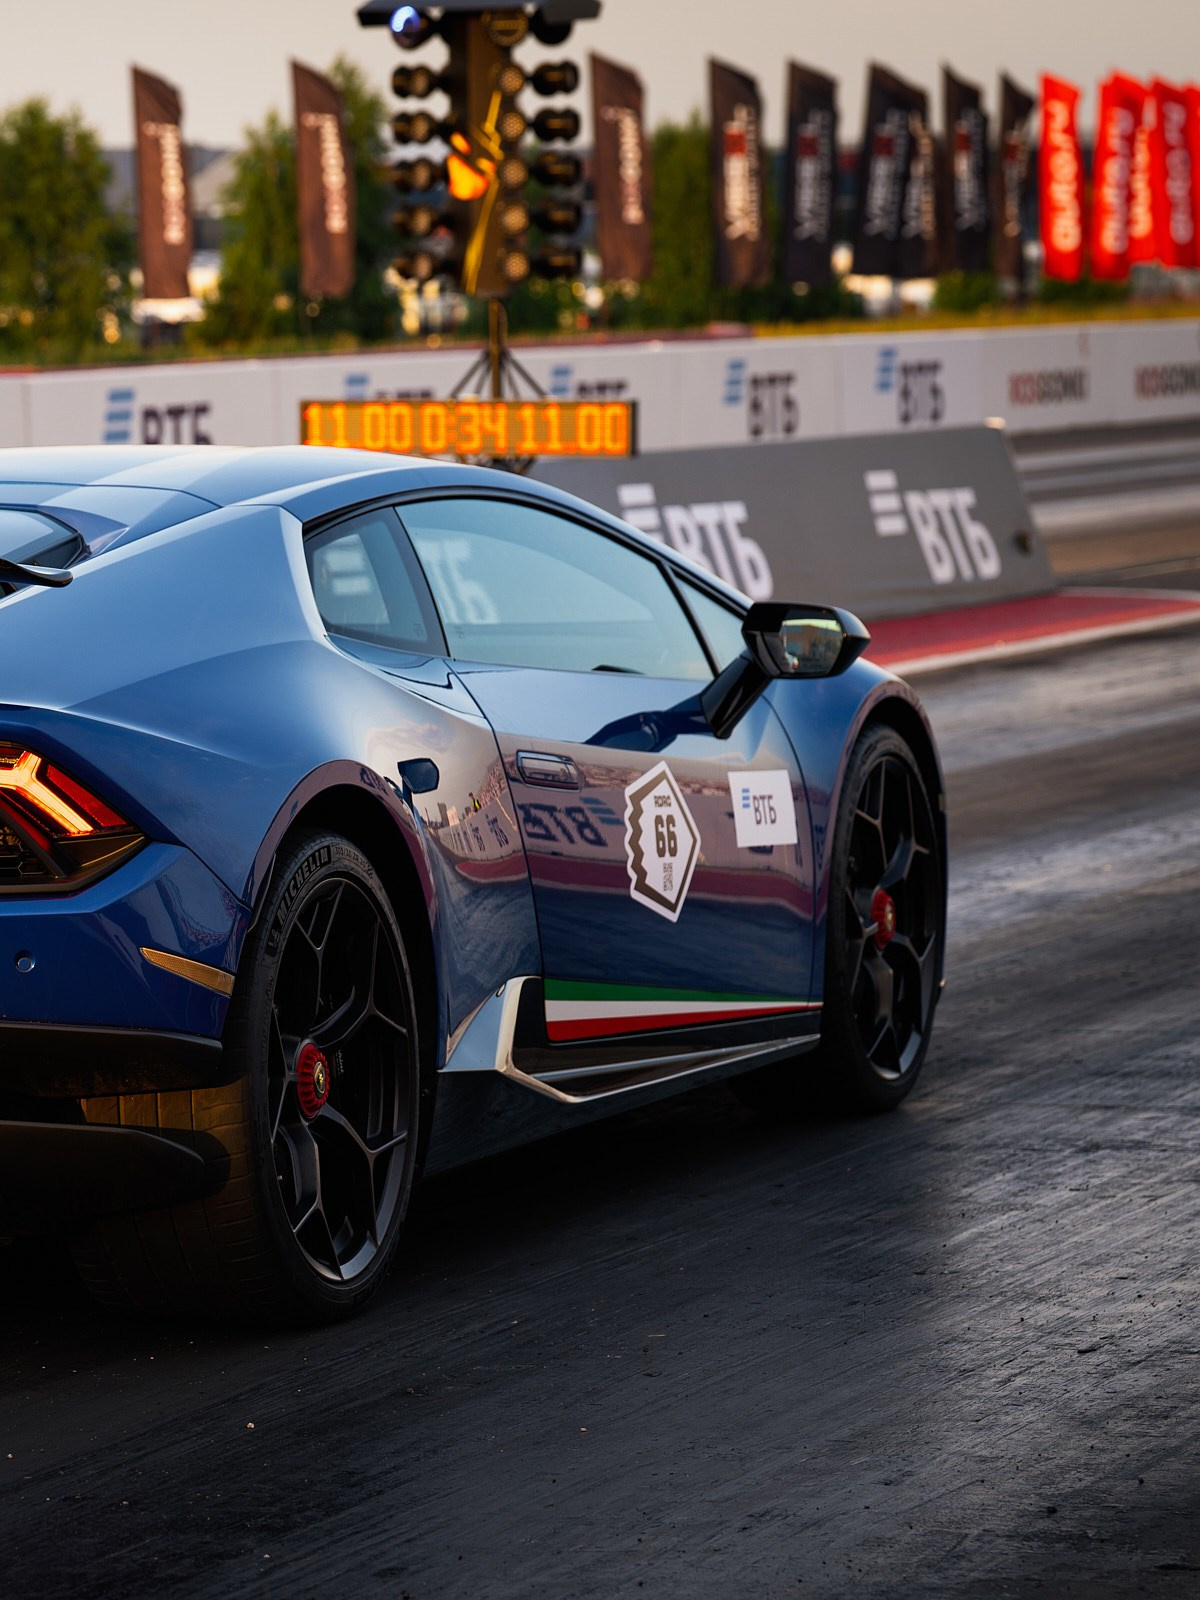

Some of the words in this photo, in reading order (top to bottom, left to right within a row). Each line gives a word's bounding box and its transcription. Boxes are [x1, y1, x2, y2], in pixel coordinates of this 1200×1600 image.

[903, 486, 1001, 584] ВТБ
[654, 814, 677, 857] 66
[753, 795, 777, 825] ВТБ
[276, 846, 330, 926] MICHELIN
